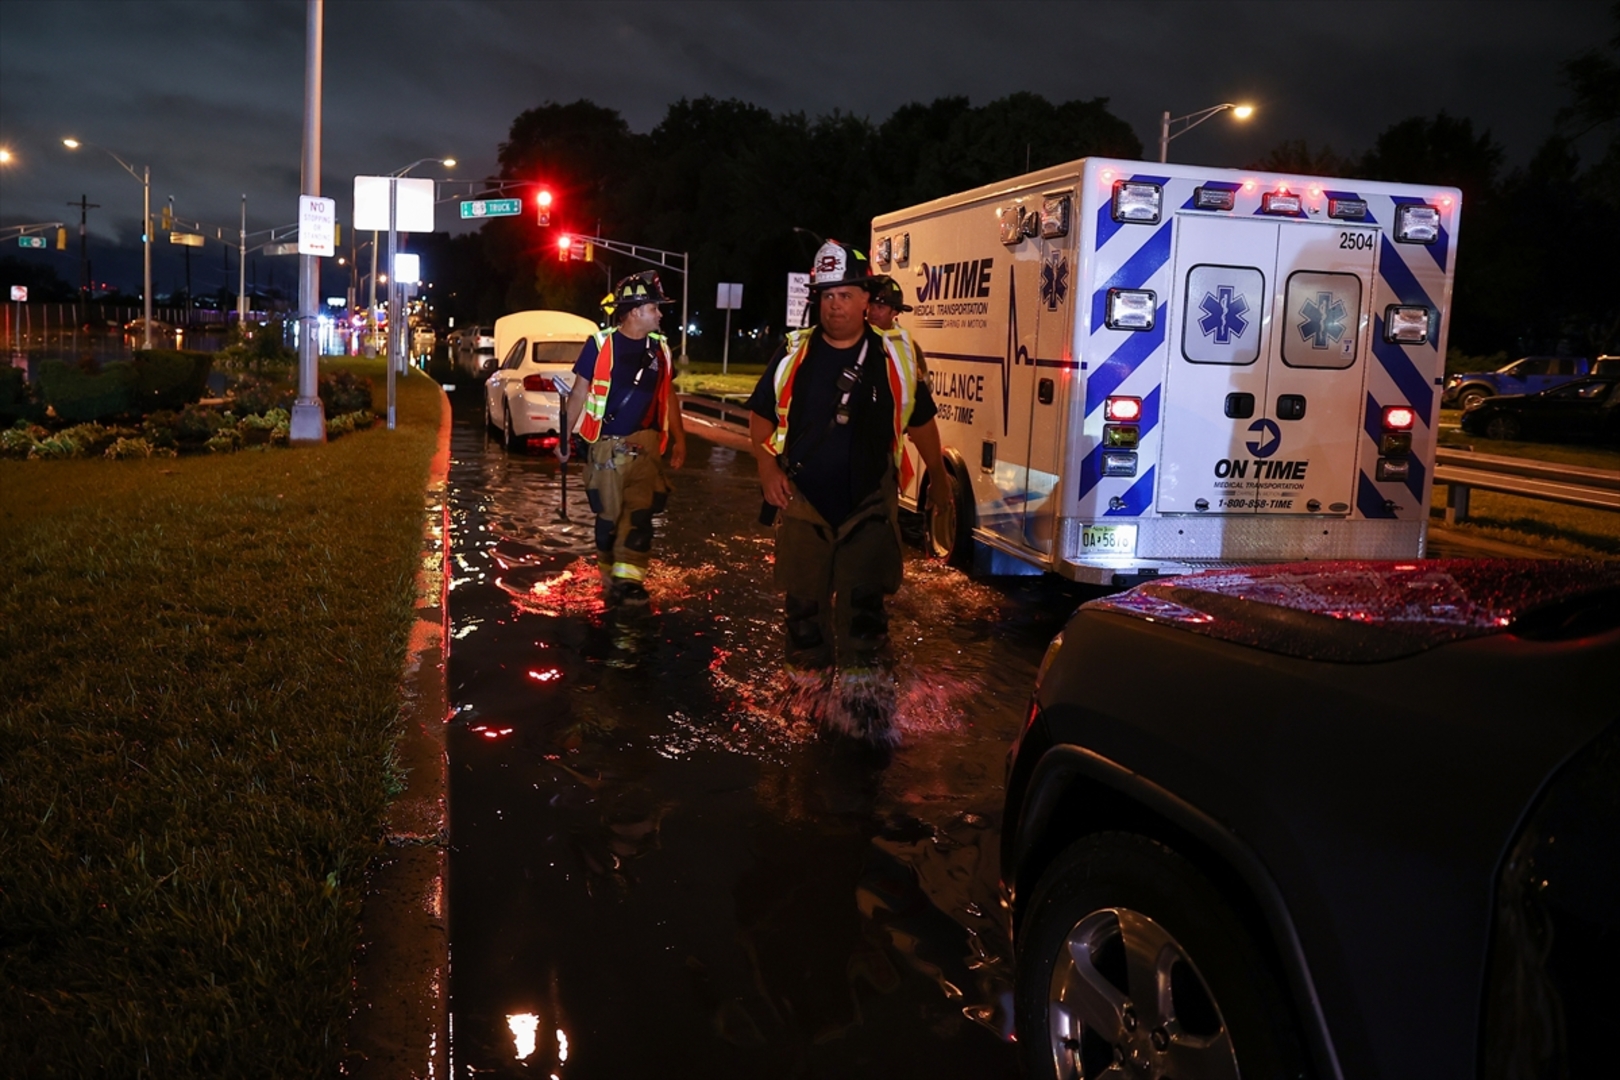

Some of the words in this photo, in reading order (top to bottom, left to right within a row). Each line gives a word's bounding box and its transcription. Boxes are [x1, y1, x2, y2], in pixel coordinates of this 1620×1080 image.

[310, 201, 325, 213] NO
[489, 203, 510, 212] TRUCK
[304, 213, 331, 224] STOPPING
[1339, 232, 1373, 250] 2504
[913, 304, 935, 316] MEDICAL
[937, 302, 989, 315] TRANSPORTATION
[943, 319, 960, 328] CARING
[967, 319, 987, 328] MOTION
[928, 370, 984, 402] BULANCE
[1214, 459, 1249, 479] ON
[1253, 460, 1309, 480] TIME
[1213, 481, 1244, 489] MEDICAL
[1245, 482, 1305, 490] TRANSPORTATION
[1218, 498, 1293, 509] 1-800-858-TIME
